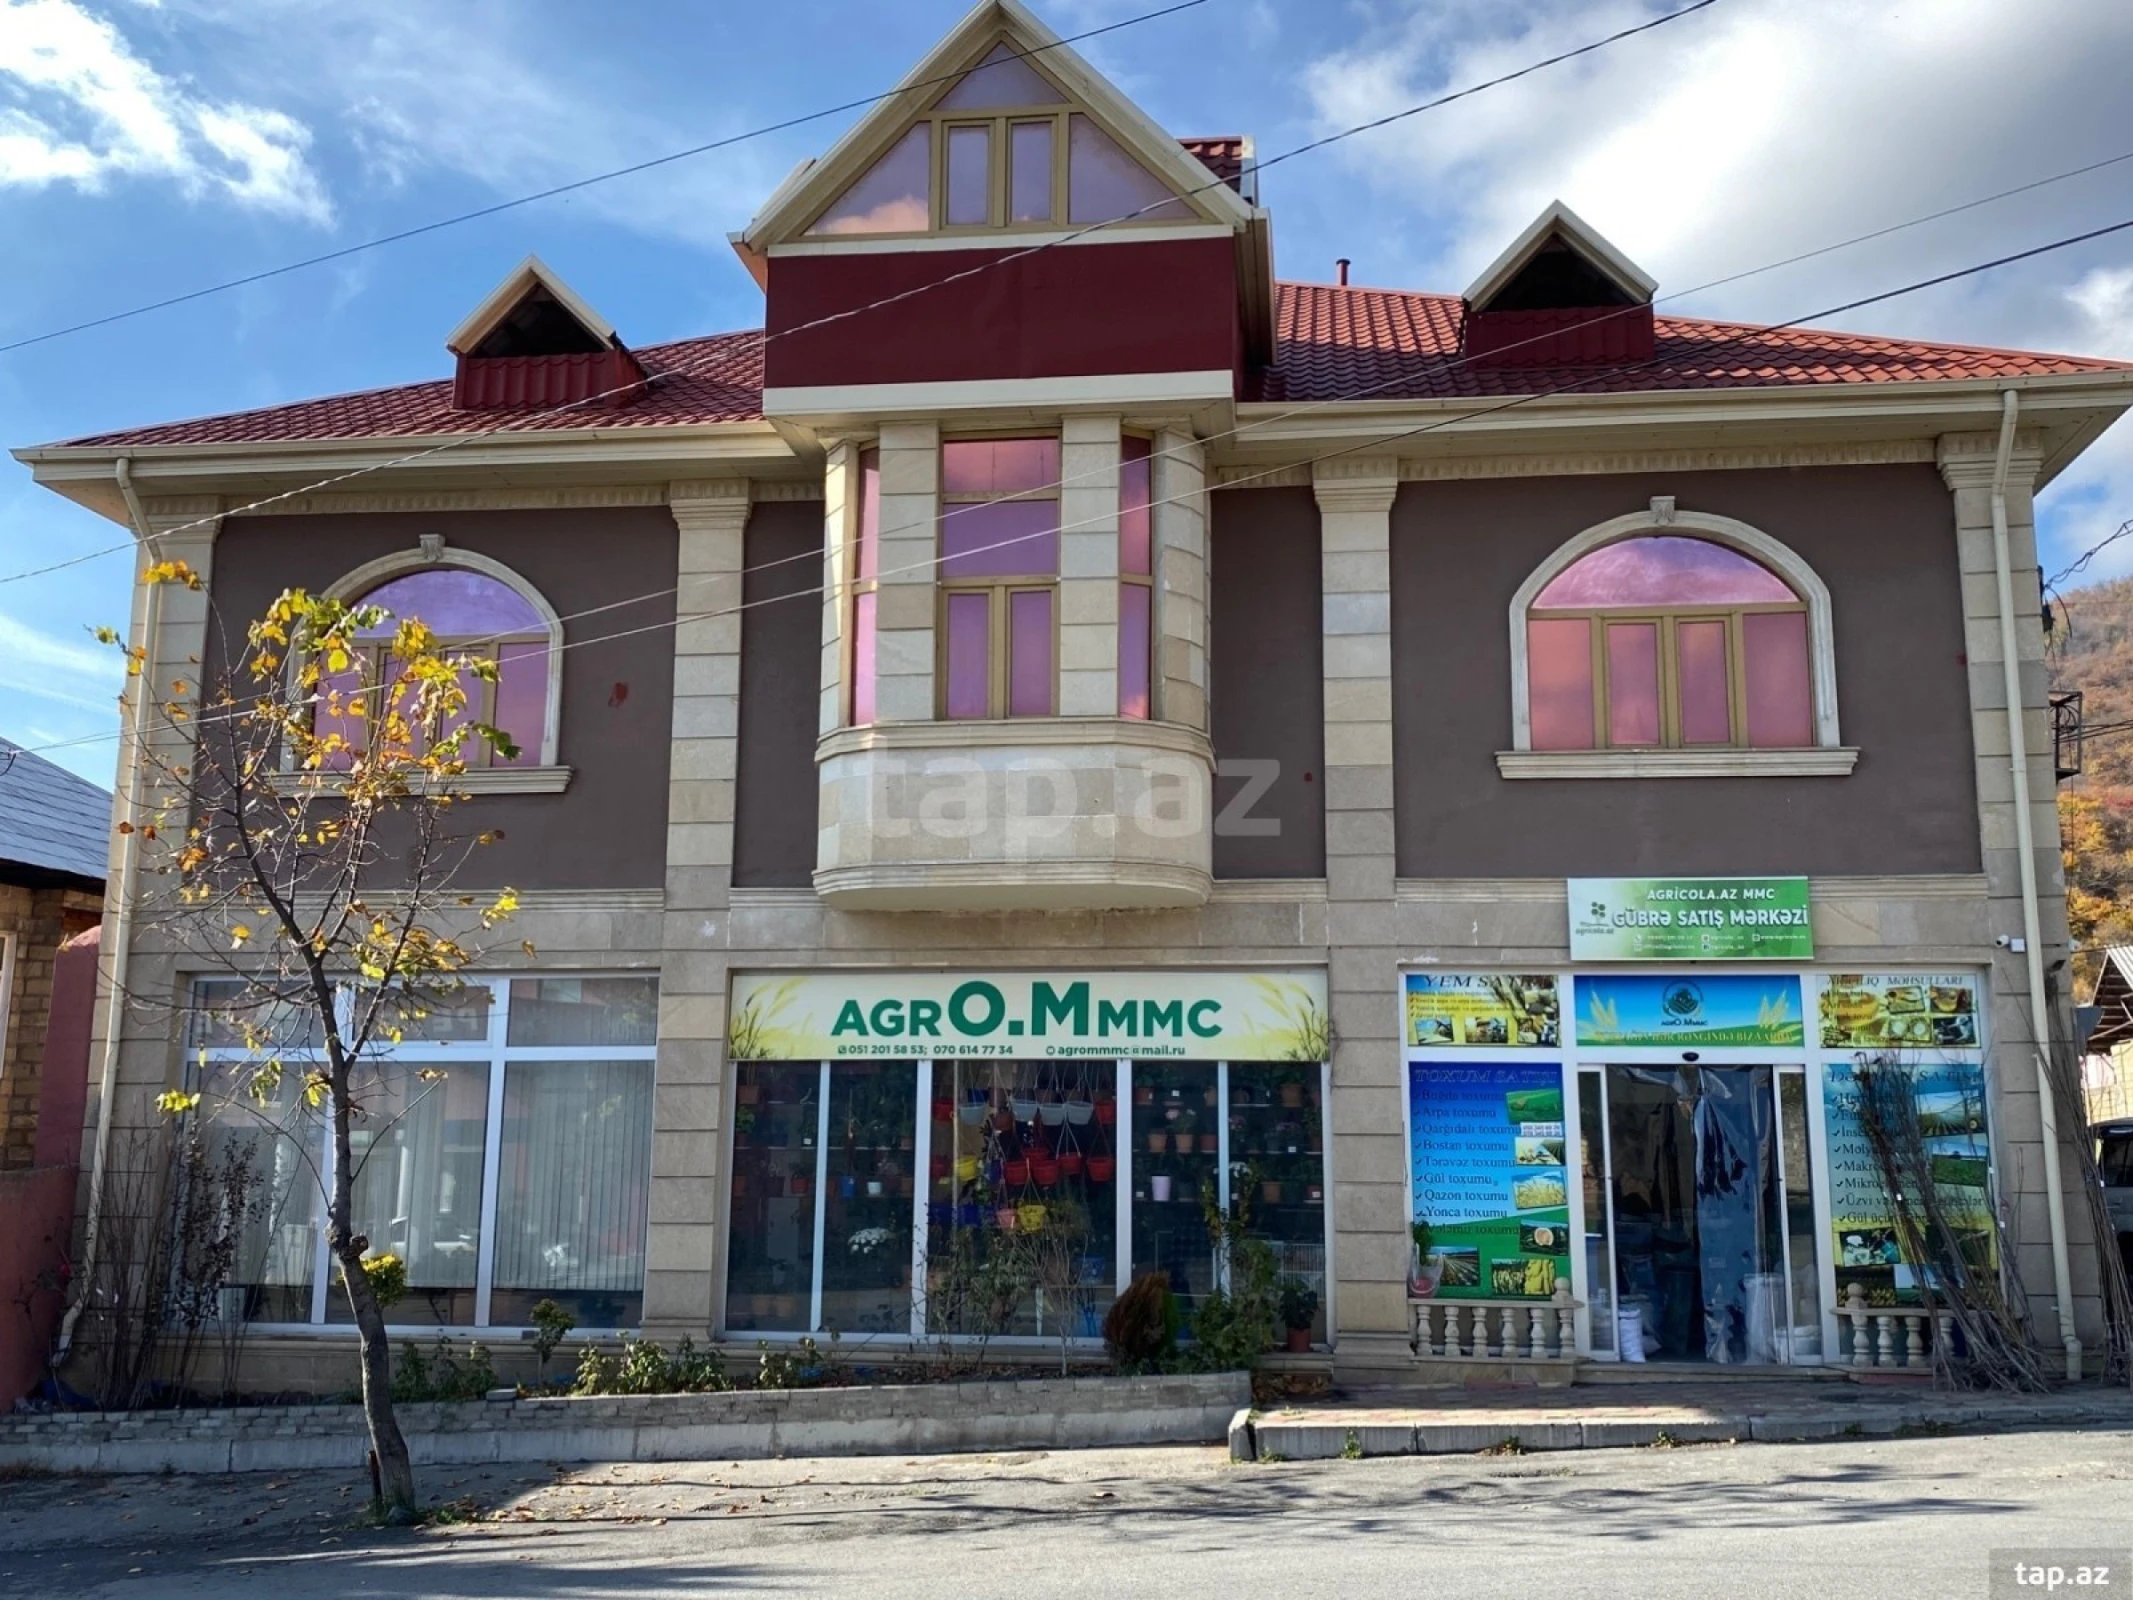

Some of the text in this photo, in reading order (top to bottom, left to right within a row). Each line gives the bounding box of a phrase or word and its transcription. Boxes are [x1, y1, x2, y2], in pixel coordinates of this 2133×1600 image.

[1647, 886, 1775, 900] AGRİCOLA.AZ MMC
[1612, 904, 1808, 930] GÜBRƏ SATIŞ MƏRKƏZİ
[1424, 975, 1471, 988] YEM
[849, 1045, 1013, 1056] 051 201 58 53; 070 614 77 34
[1057, 1045, 1186, 1057] agrommmc@mail.ru
[1415, 1069, 1490, 1083] TOXUM
[1422, 1107, 1497, 1120] Arpa toxumu
[1479, 1125, 1521, 1135] toxumu
[1423, 1139, 1508, 1151] Bostan toxumu
[1424, 1156, 1515, 1168] Tərəvəz toxumu
[1424, 1172, 1493, 1185] Gül toxumu
[1424, 1188, 1508, 1202] Qazon toxumu
[1845, 1191, 1872, 1206] Üzvi
[1426, 1205, 1508, 1218] Yonca toxumu
[1847, 1211, 1868, 1223] Gül
[1476, 1225, 1520, 1235] toxumu
